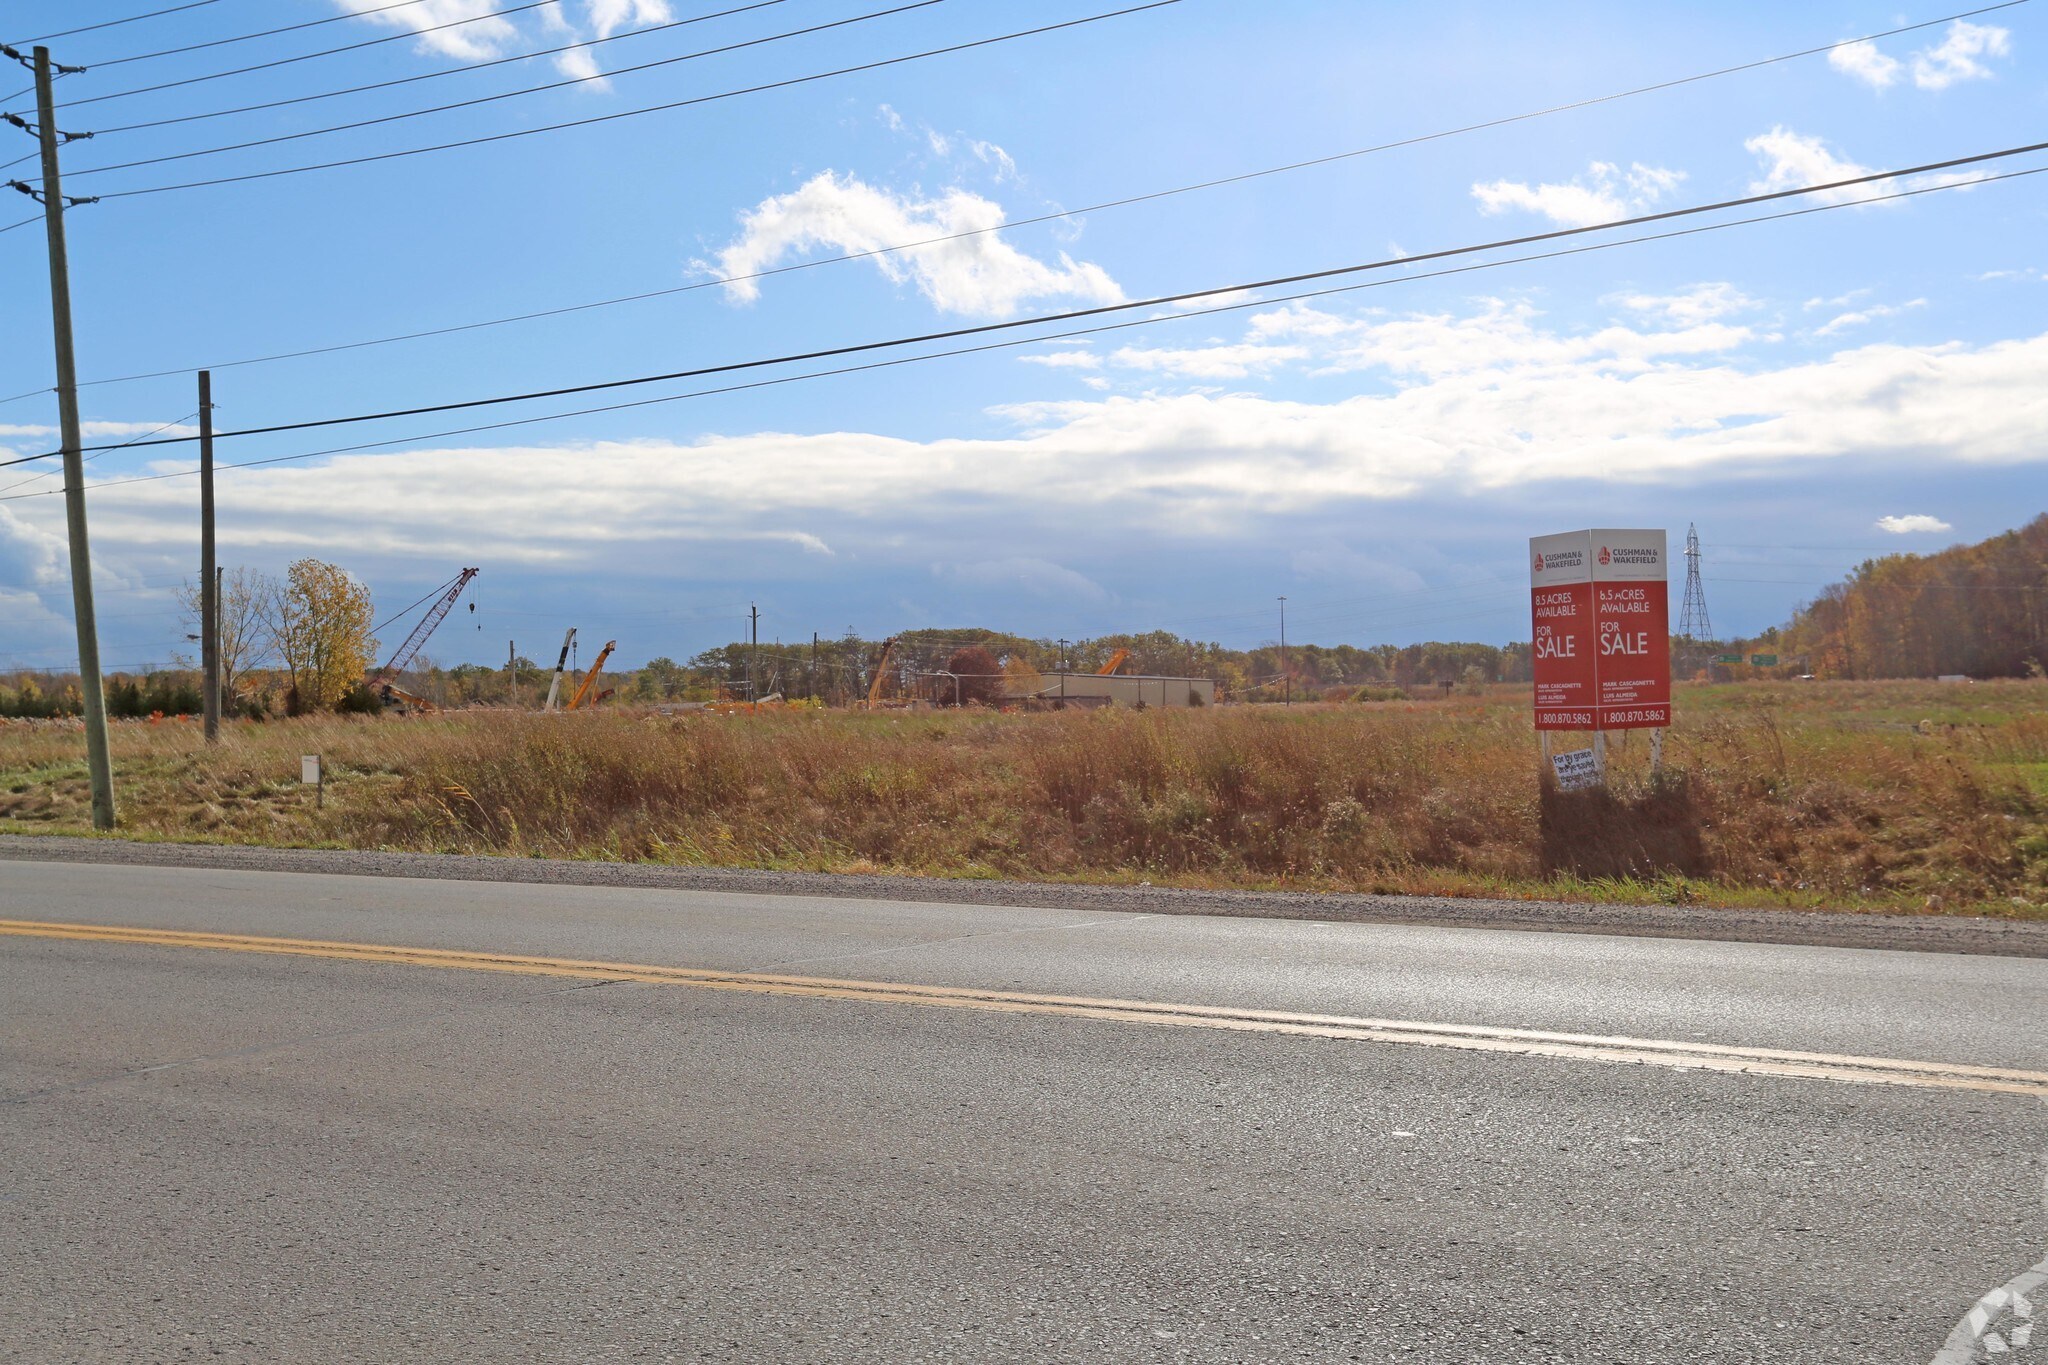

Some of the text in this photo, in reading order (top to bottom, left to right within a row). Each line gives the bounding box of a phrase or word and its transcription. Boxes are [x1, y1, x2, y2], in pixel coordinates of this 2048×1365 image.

[1545, 550, 1583, 561] CUSHMAN &
[1613, 548, 1658, 556] CUSHMAN &
[1545, 558, 1582, 569] WAKEFIELD
[1613, 556, 1657, 564] WAKEFIELD
[1535, 592, 1572, 606] 8.5 ACRES
[1614, 589, 1645, 601] ACRES
[1536, 604, 1576, 618] AVAILABLE
[1600, 602, 1650, 613] AVAILABLE
[1536, 625, 1552, 636] FOR
[1600, 622, 1620, 632] FOR
[1536, 635, 1576, 659] SALE
[1600, 632, 1648, 656] SALE
[1538, 713, 1592, 724] 1.800.870.5862
[1603, 710, 1665, 723] 1.800.870.5862
[1553, 755, 1564, 764] For
[1573, 751, 1592, 761] grace
